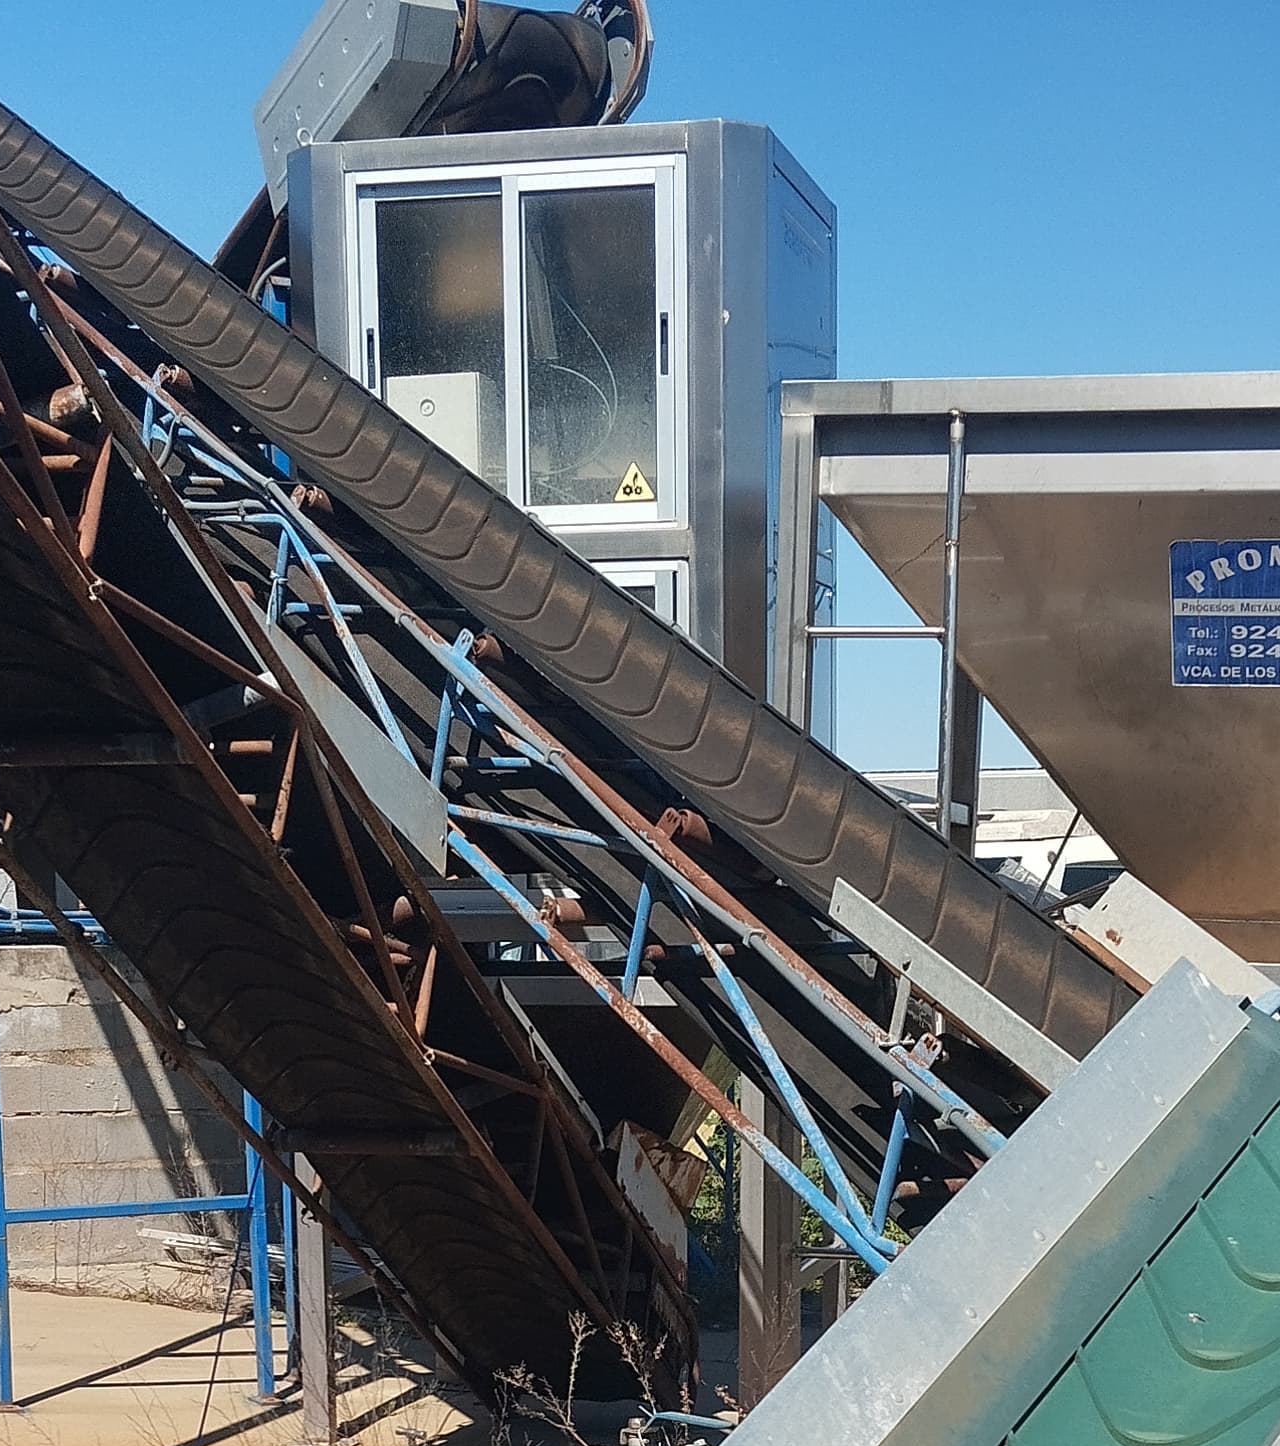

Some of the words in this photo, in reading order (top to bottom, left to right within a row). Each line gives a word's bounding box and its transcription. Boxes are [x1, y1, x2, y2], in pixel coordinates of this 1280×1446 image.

[1181, 602, 1235, 613] PROCESOS
[1187, 644, 1218, 657] Fax:
[1181, 665, 1217, 678] VCA.
[1220, 666, 1241, 678] DE
[1245, 666, 1276, 678] LOS
